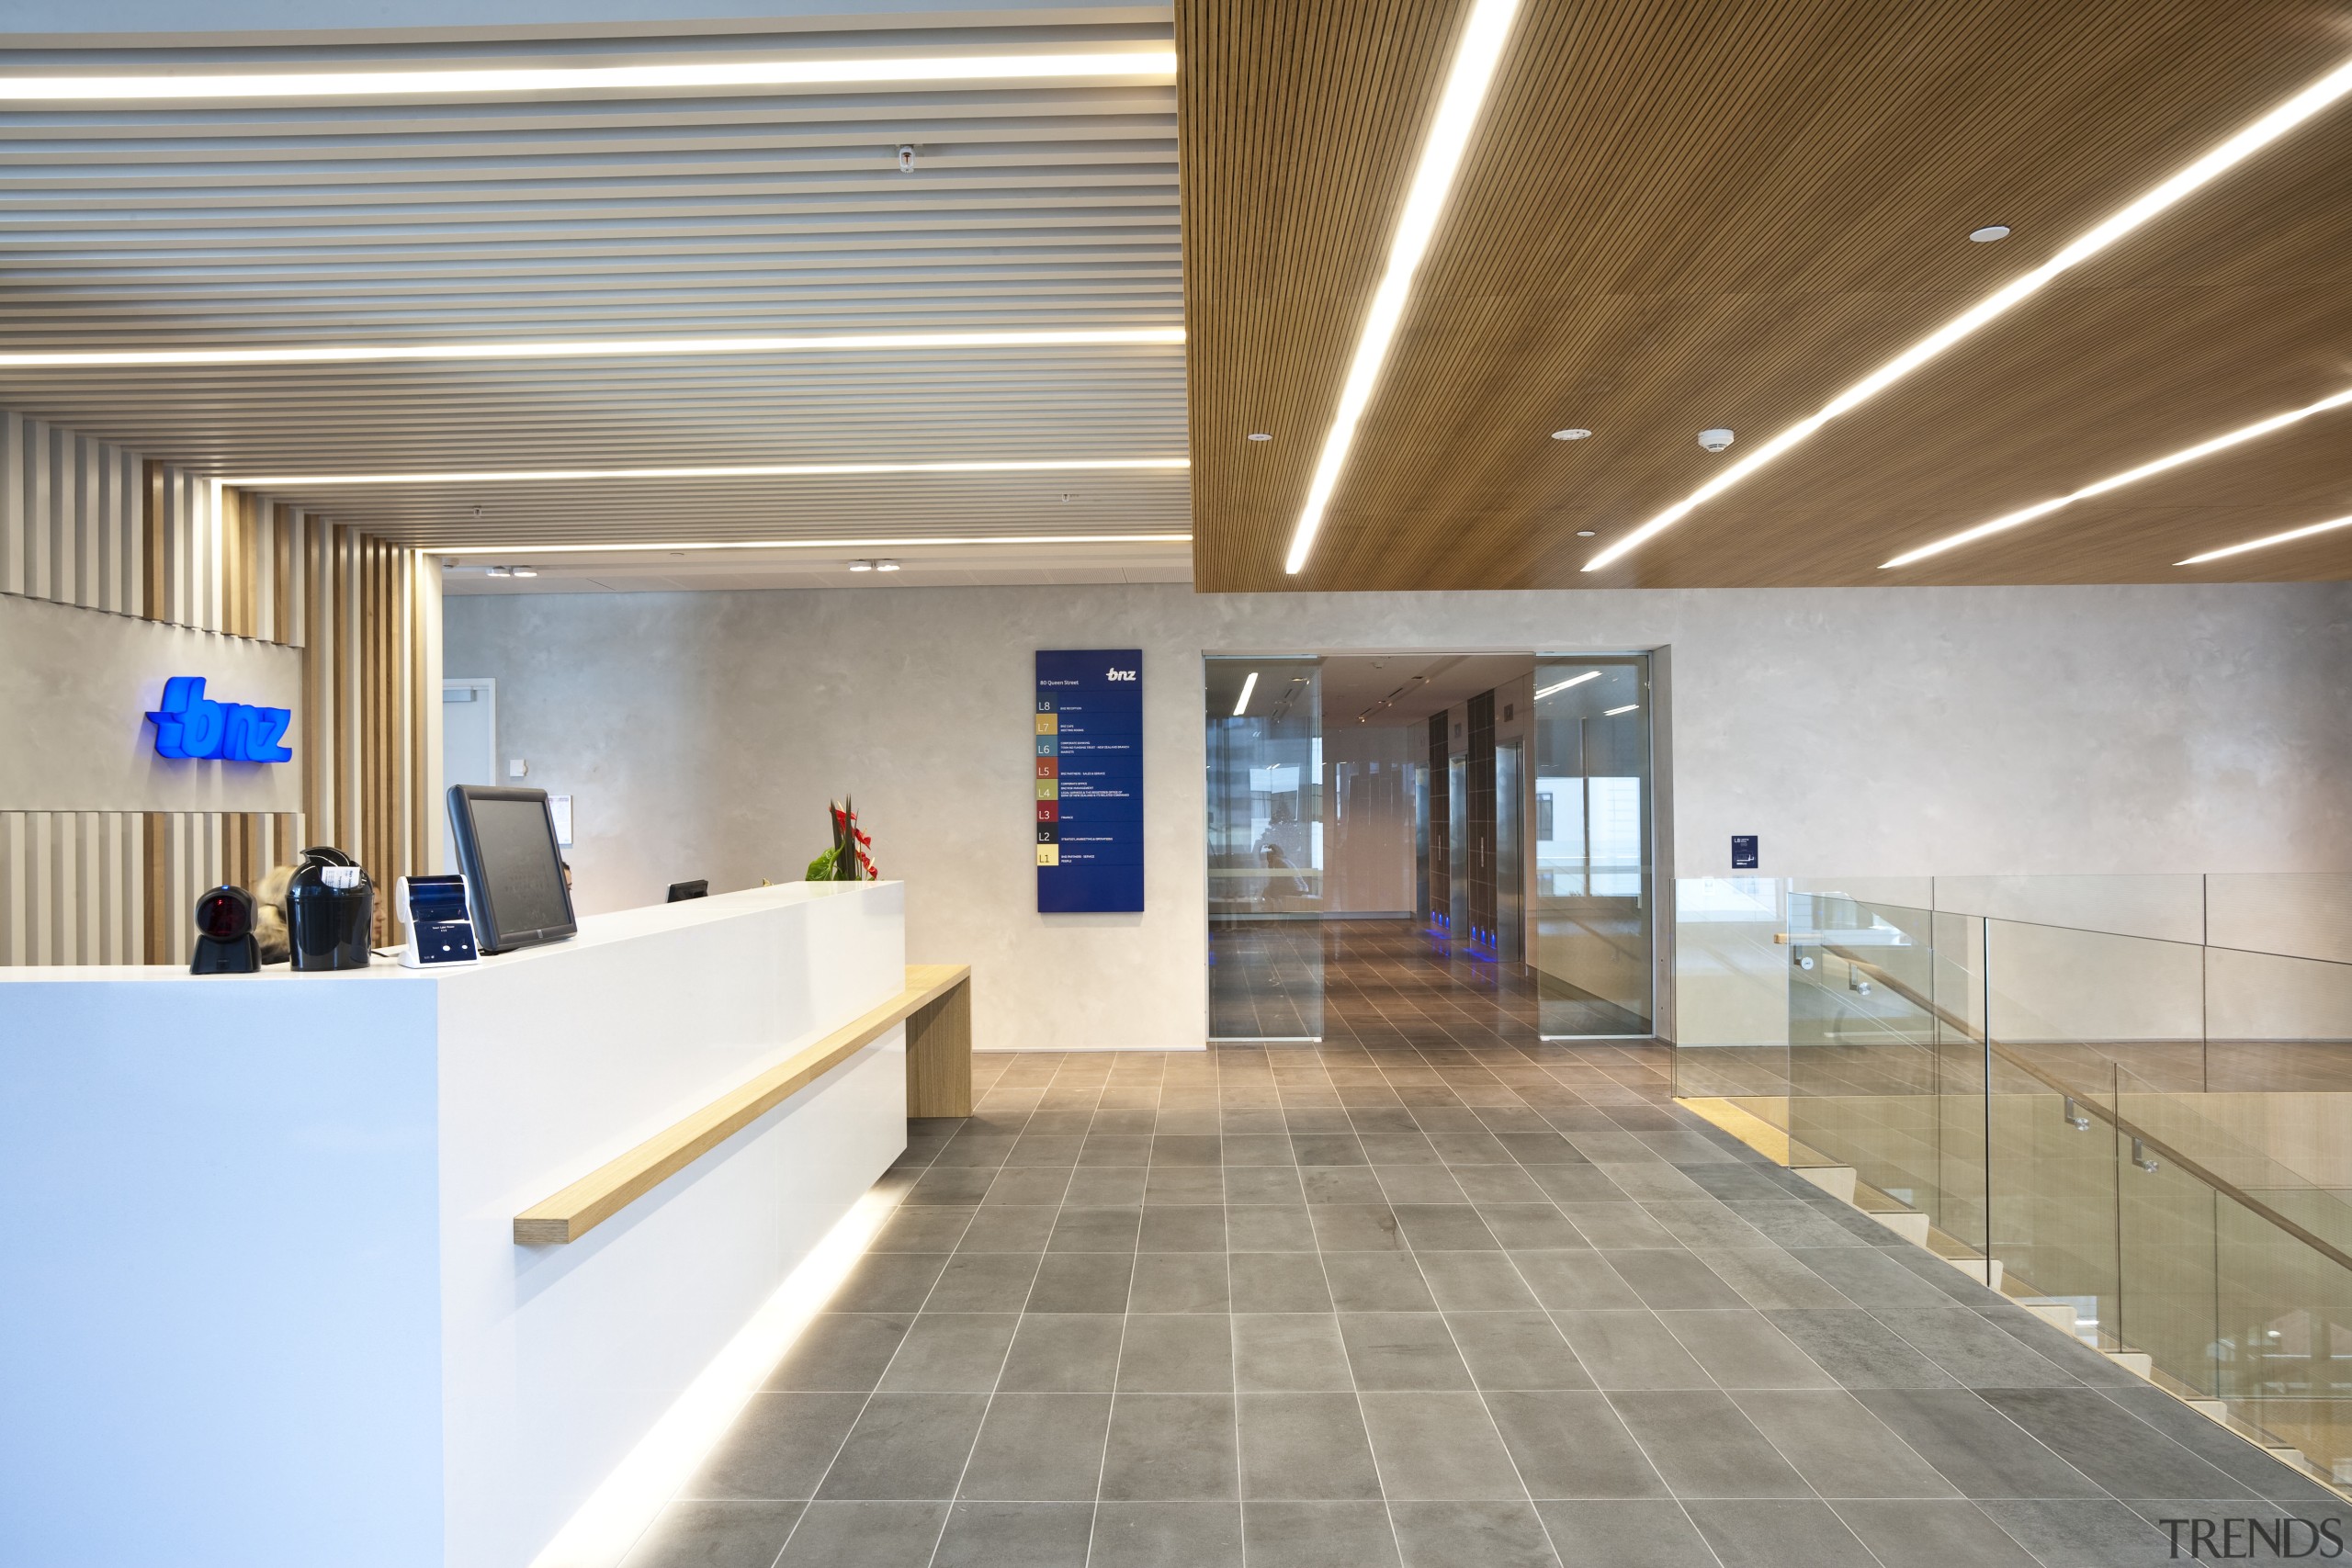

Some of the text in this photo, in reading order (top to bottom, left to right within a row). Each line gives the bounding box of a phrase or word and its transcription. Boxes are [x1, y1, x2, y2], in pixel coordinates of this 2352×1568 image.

[1105, 667, 1136, 681] bnz
[1038, 702, 1050, 711] L8
[145, 676, 292, 763] bnz
[1038, 723, 1049, 732] L7
[1038, 745, 1050, 754] L6
[1038, 767, 1049, 776] L5
[1038, 788, 1050, 798] L4
[1039, 811, 1050, 819] L3
[1039, 832, 1050, 841] L2
[1039, 855, 1049, 863] L1
